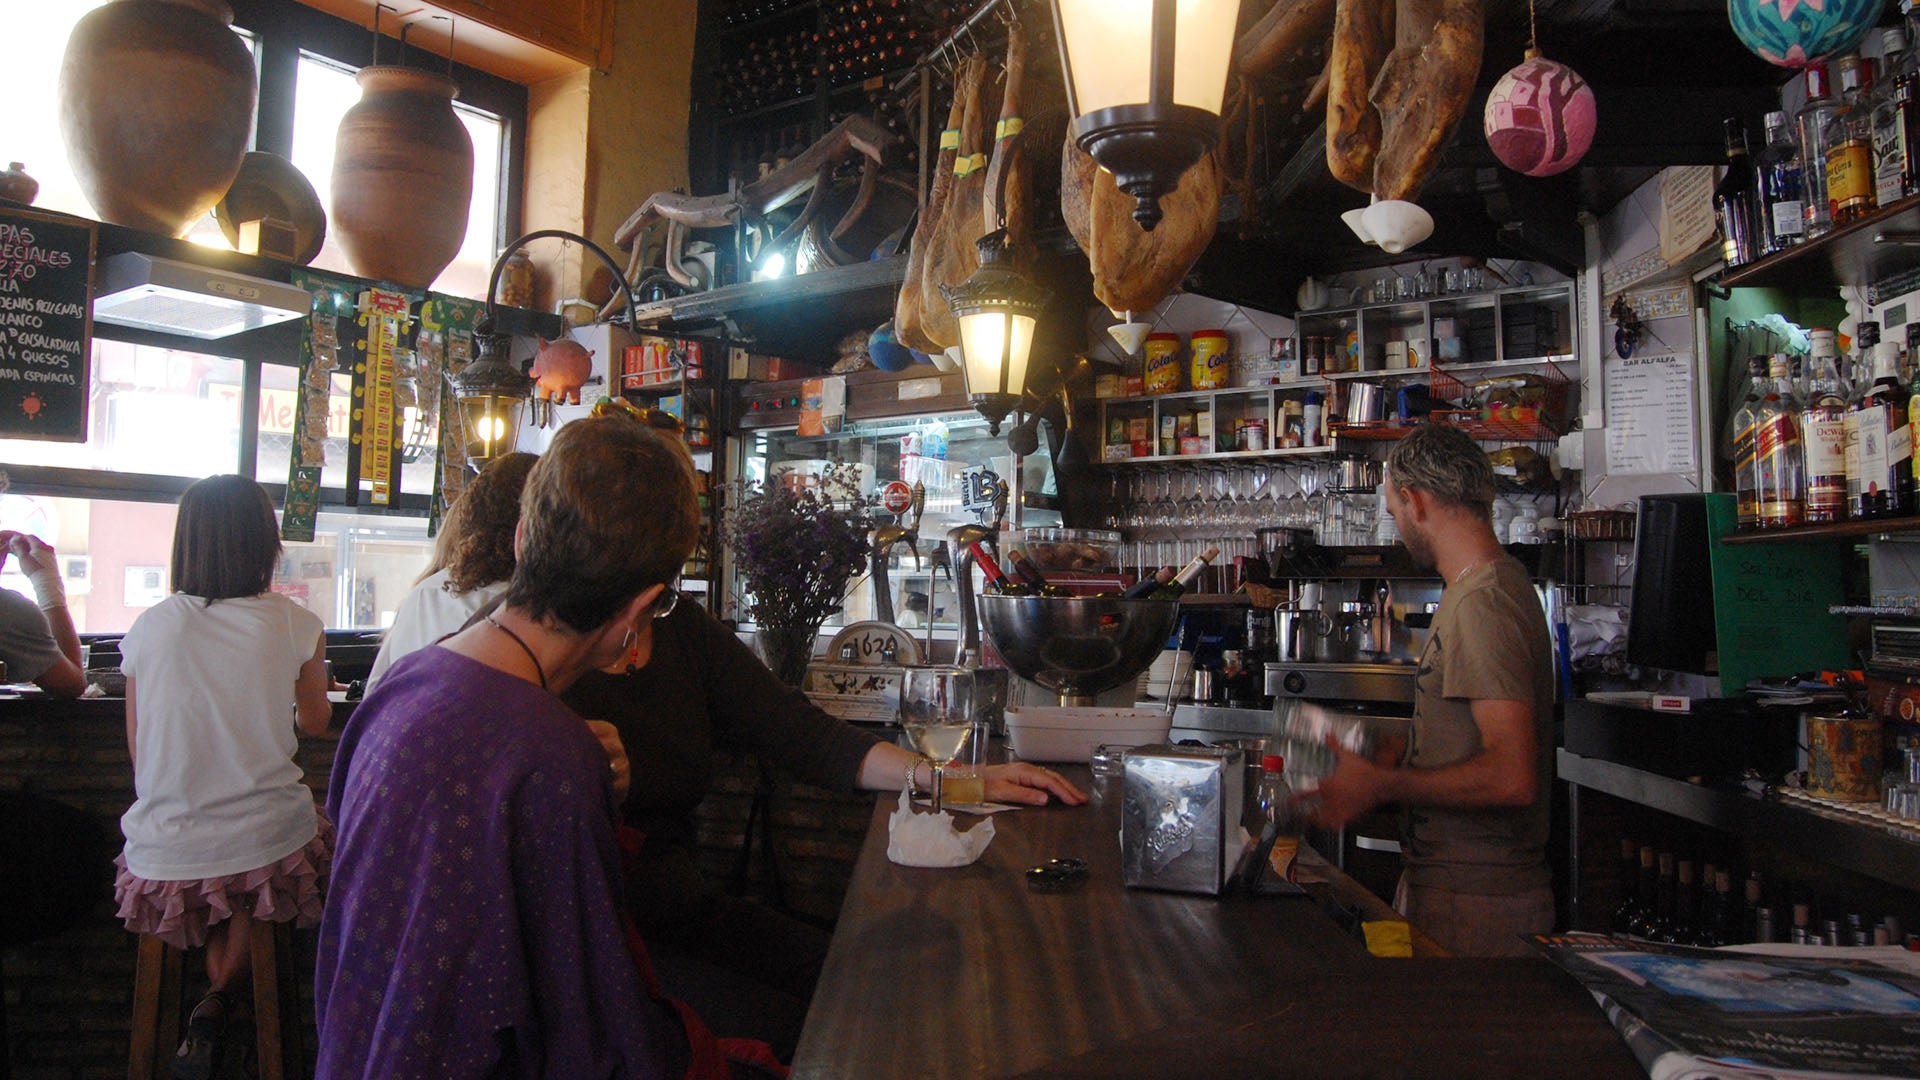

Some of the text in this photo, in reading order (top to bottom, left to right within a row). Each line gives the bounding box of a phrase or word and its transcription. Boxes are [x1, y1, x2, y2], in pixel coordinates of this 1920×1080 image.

[0, 313, 43, 328] LANCO
[8, 345, 16, 359] 4
[21, 350, 69, 368] QUESOS
[1640, 356, 1677, 365] ALFALFA
[24, 370, 76, 386] ESPINACAS
